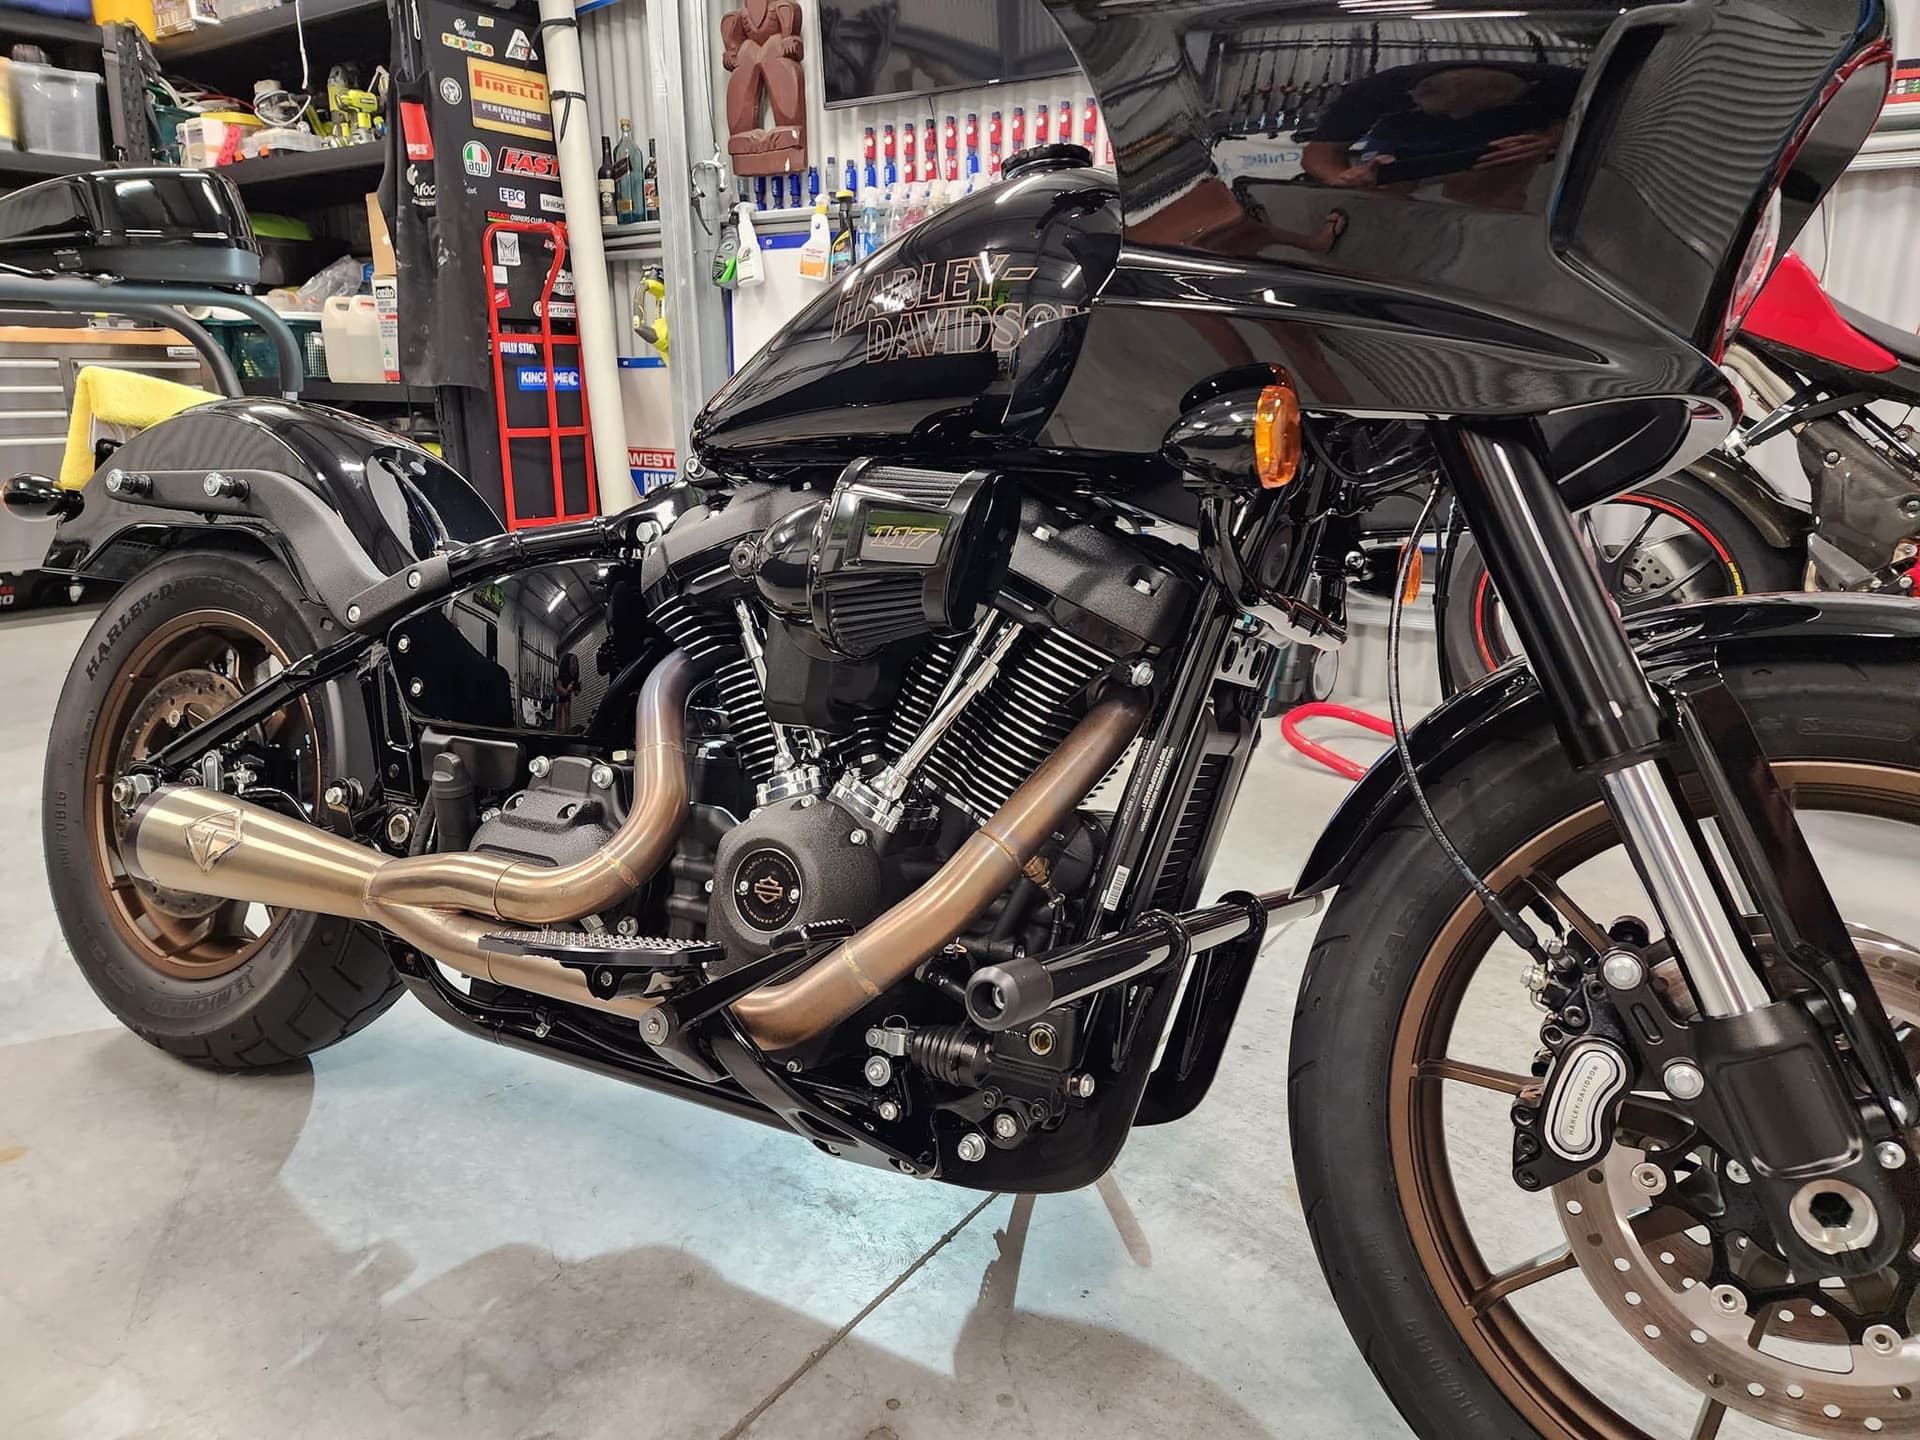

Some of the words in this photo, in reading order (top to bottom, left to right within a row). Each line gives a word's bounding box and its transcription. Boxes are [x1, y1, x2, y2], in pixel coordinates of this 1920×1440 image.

[474, 70, 544, 100] PIRELLI
[482, 103, 542, 121] PERFORMANCE
[500, 114, 527, 124] TYRES
[501, 190, 524, 202] EBC
[500, 342, 518, 353] FULLY
[521, 371, 569, 385] KINCME
[629, 453, 676, 467] WEST
[870, 526, 940, 549] 117
